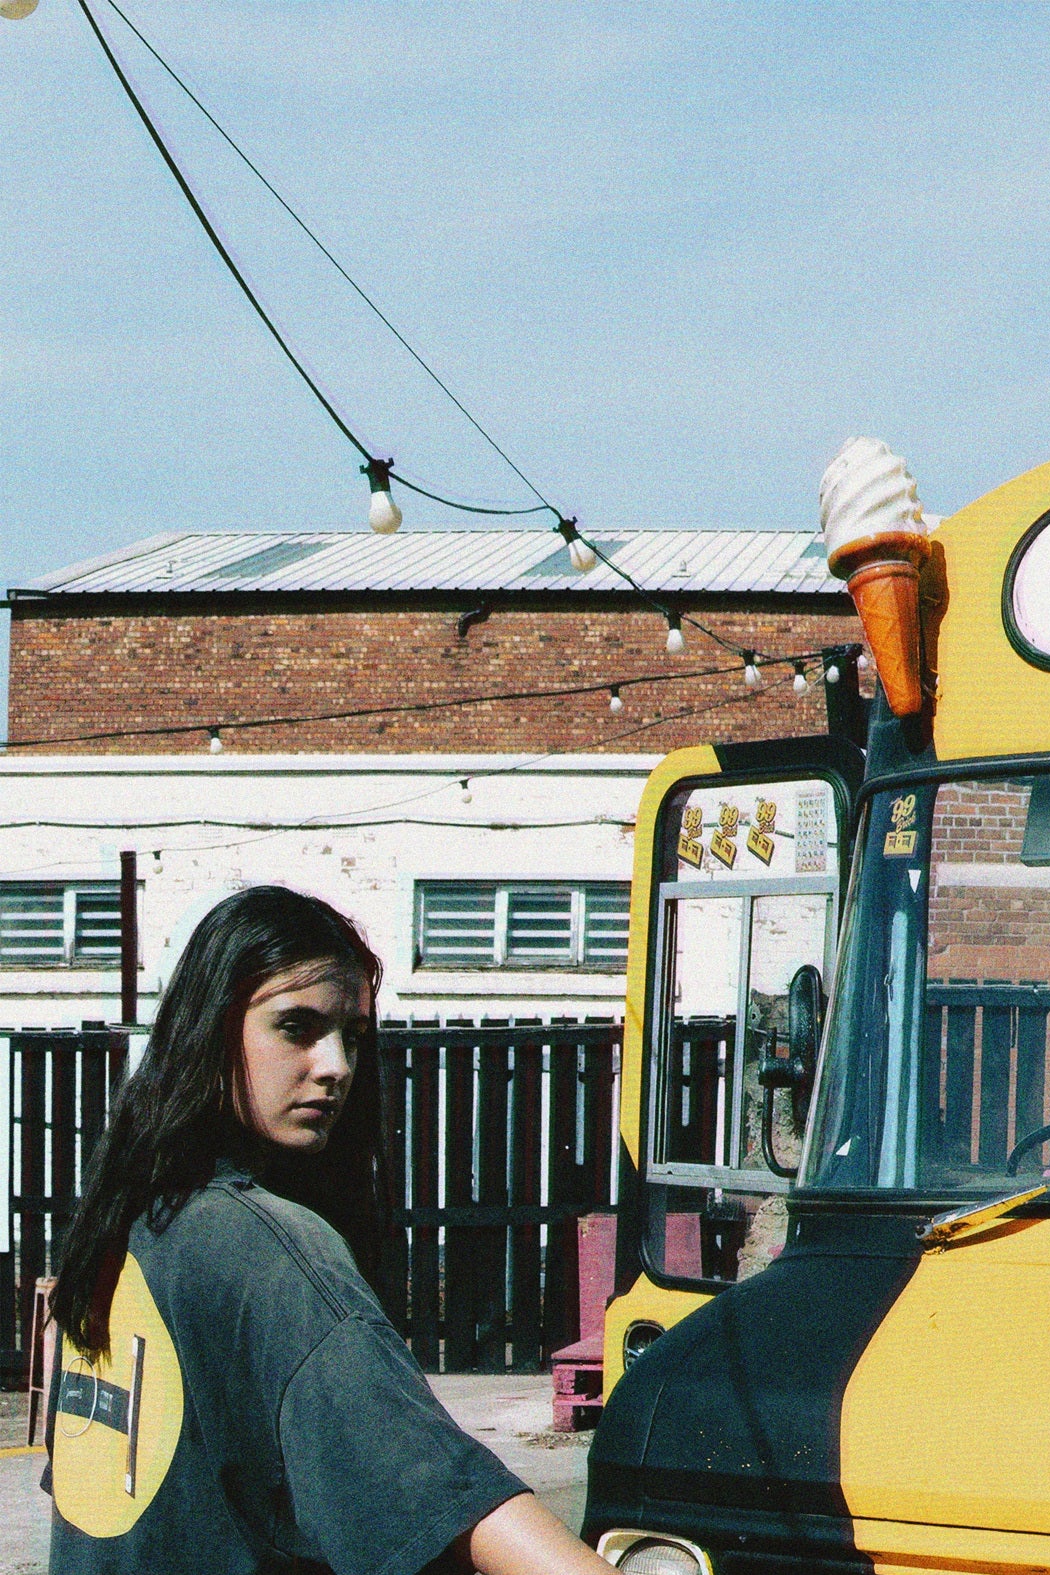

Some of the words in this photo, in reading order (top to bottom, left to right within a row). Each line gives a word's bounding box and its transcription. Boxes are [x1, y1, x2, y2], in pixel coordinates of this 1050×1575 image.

[683, 806, 703, 830] 99
[719, 805, 740, 828] 99
[756, 801, 777, 824] 99
[890, 794, 916, 824] 99
